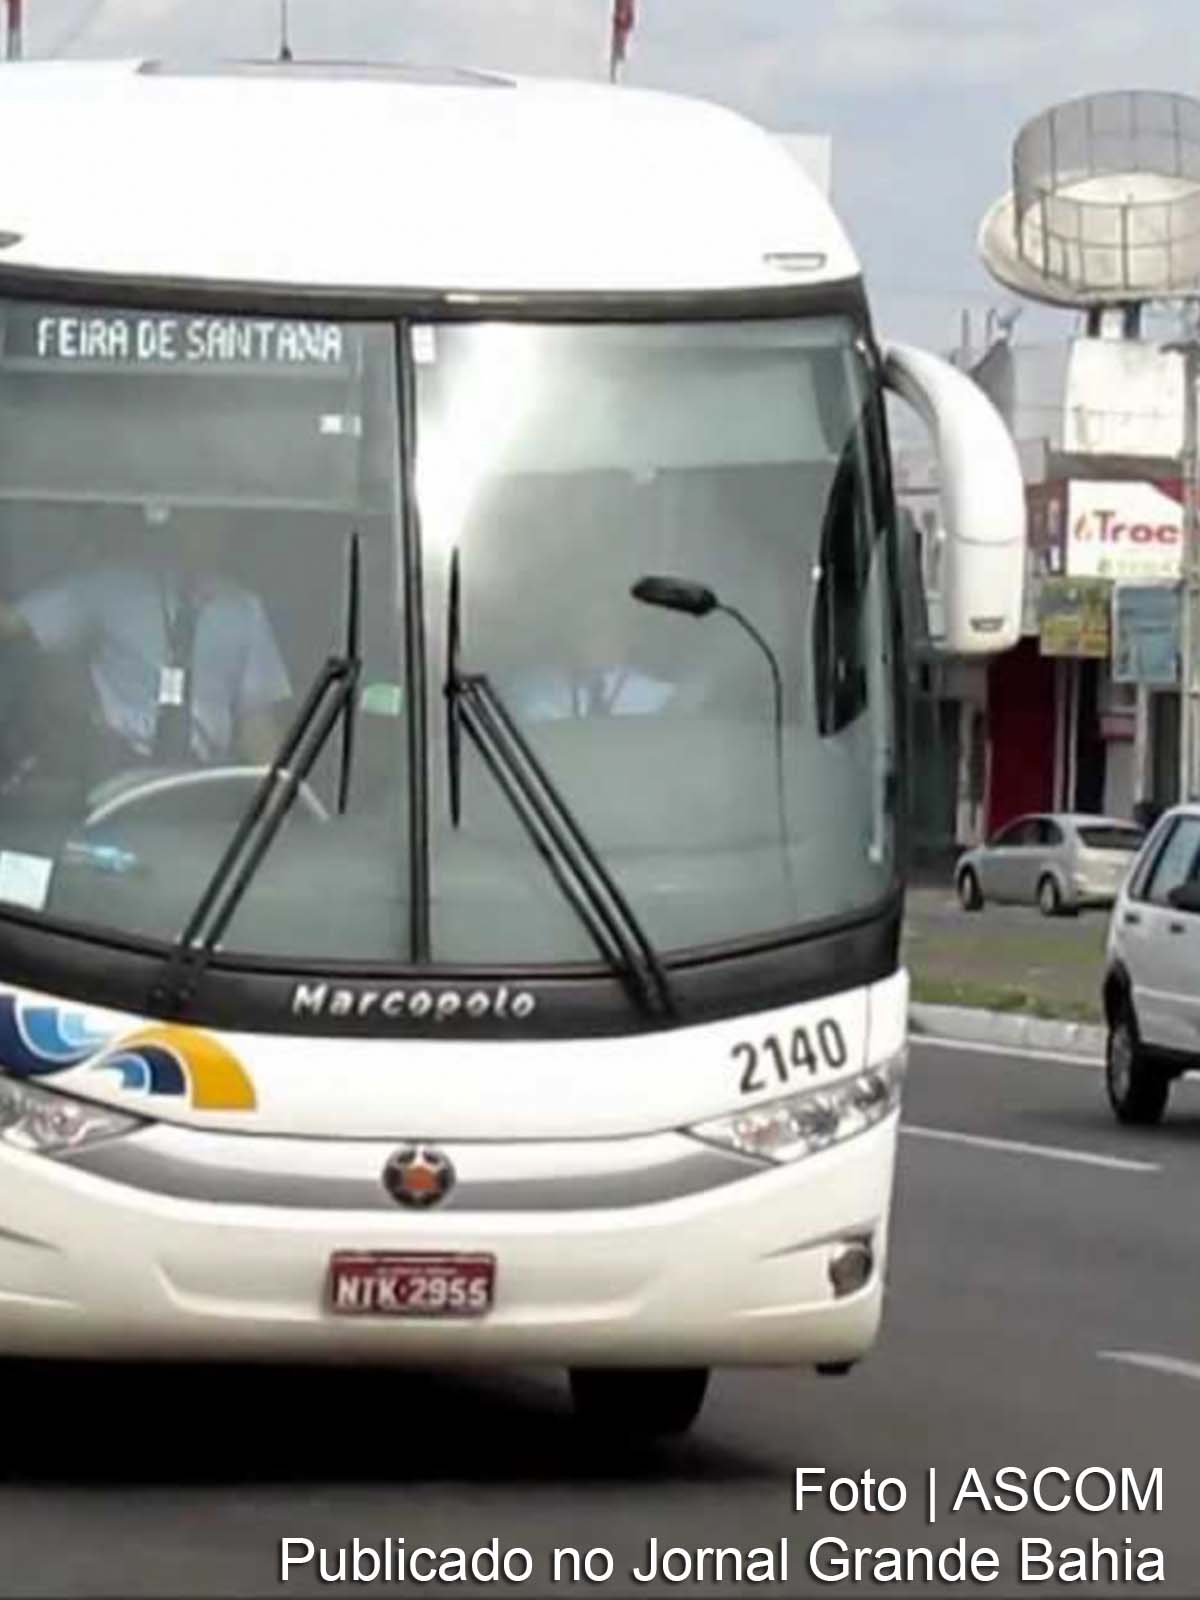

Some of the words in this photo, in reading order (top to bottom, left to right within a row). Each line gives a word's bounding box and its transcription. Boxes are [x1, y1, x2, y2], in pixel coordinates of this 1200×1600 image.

[37, 316, 128, 358] FEIRA
[136, 319, 179, 359] DE
[186, 322, 343, 362] SANTANA
[292, 982, 535, 1021] Marcopolo
[730, 1017, 848, 1095] 2140
